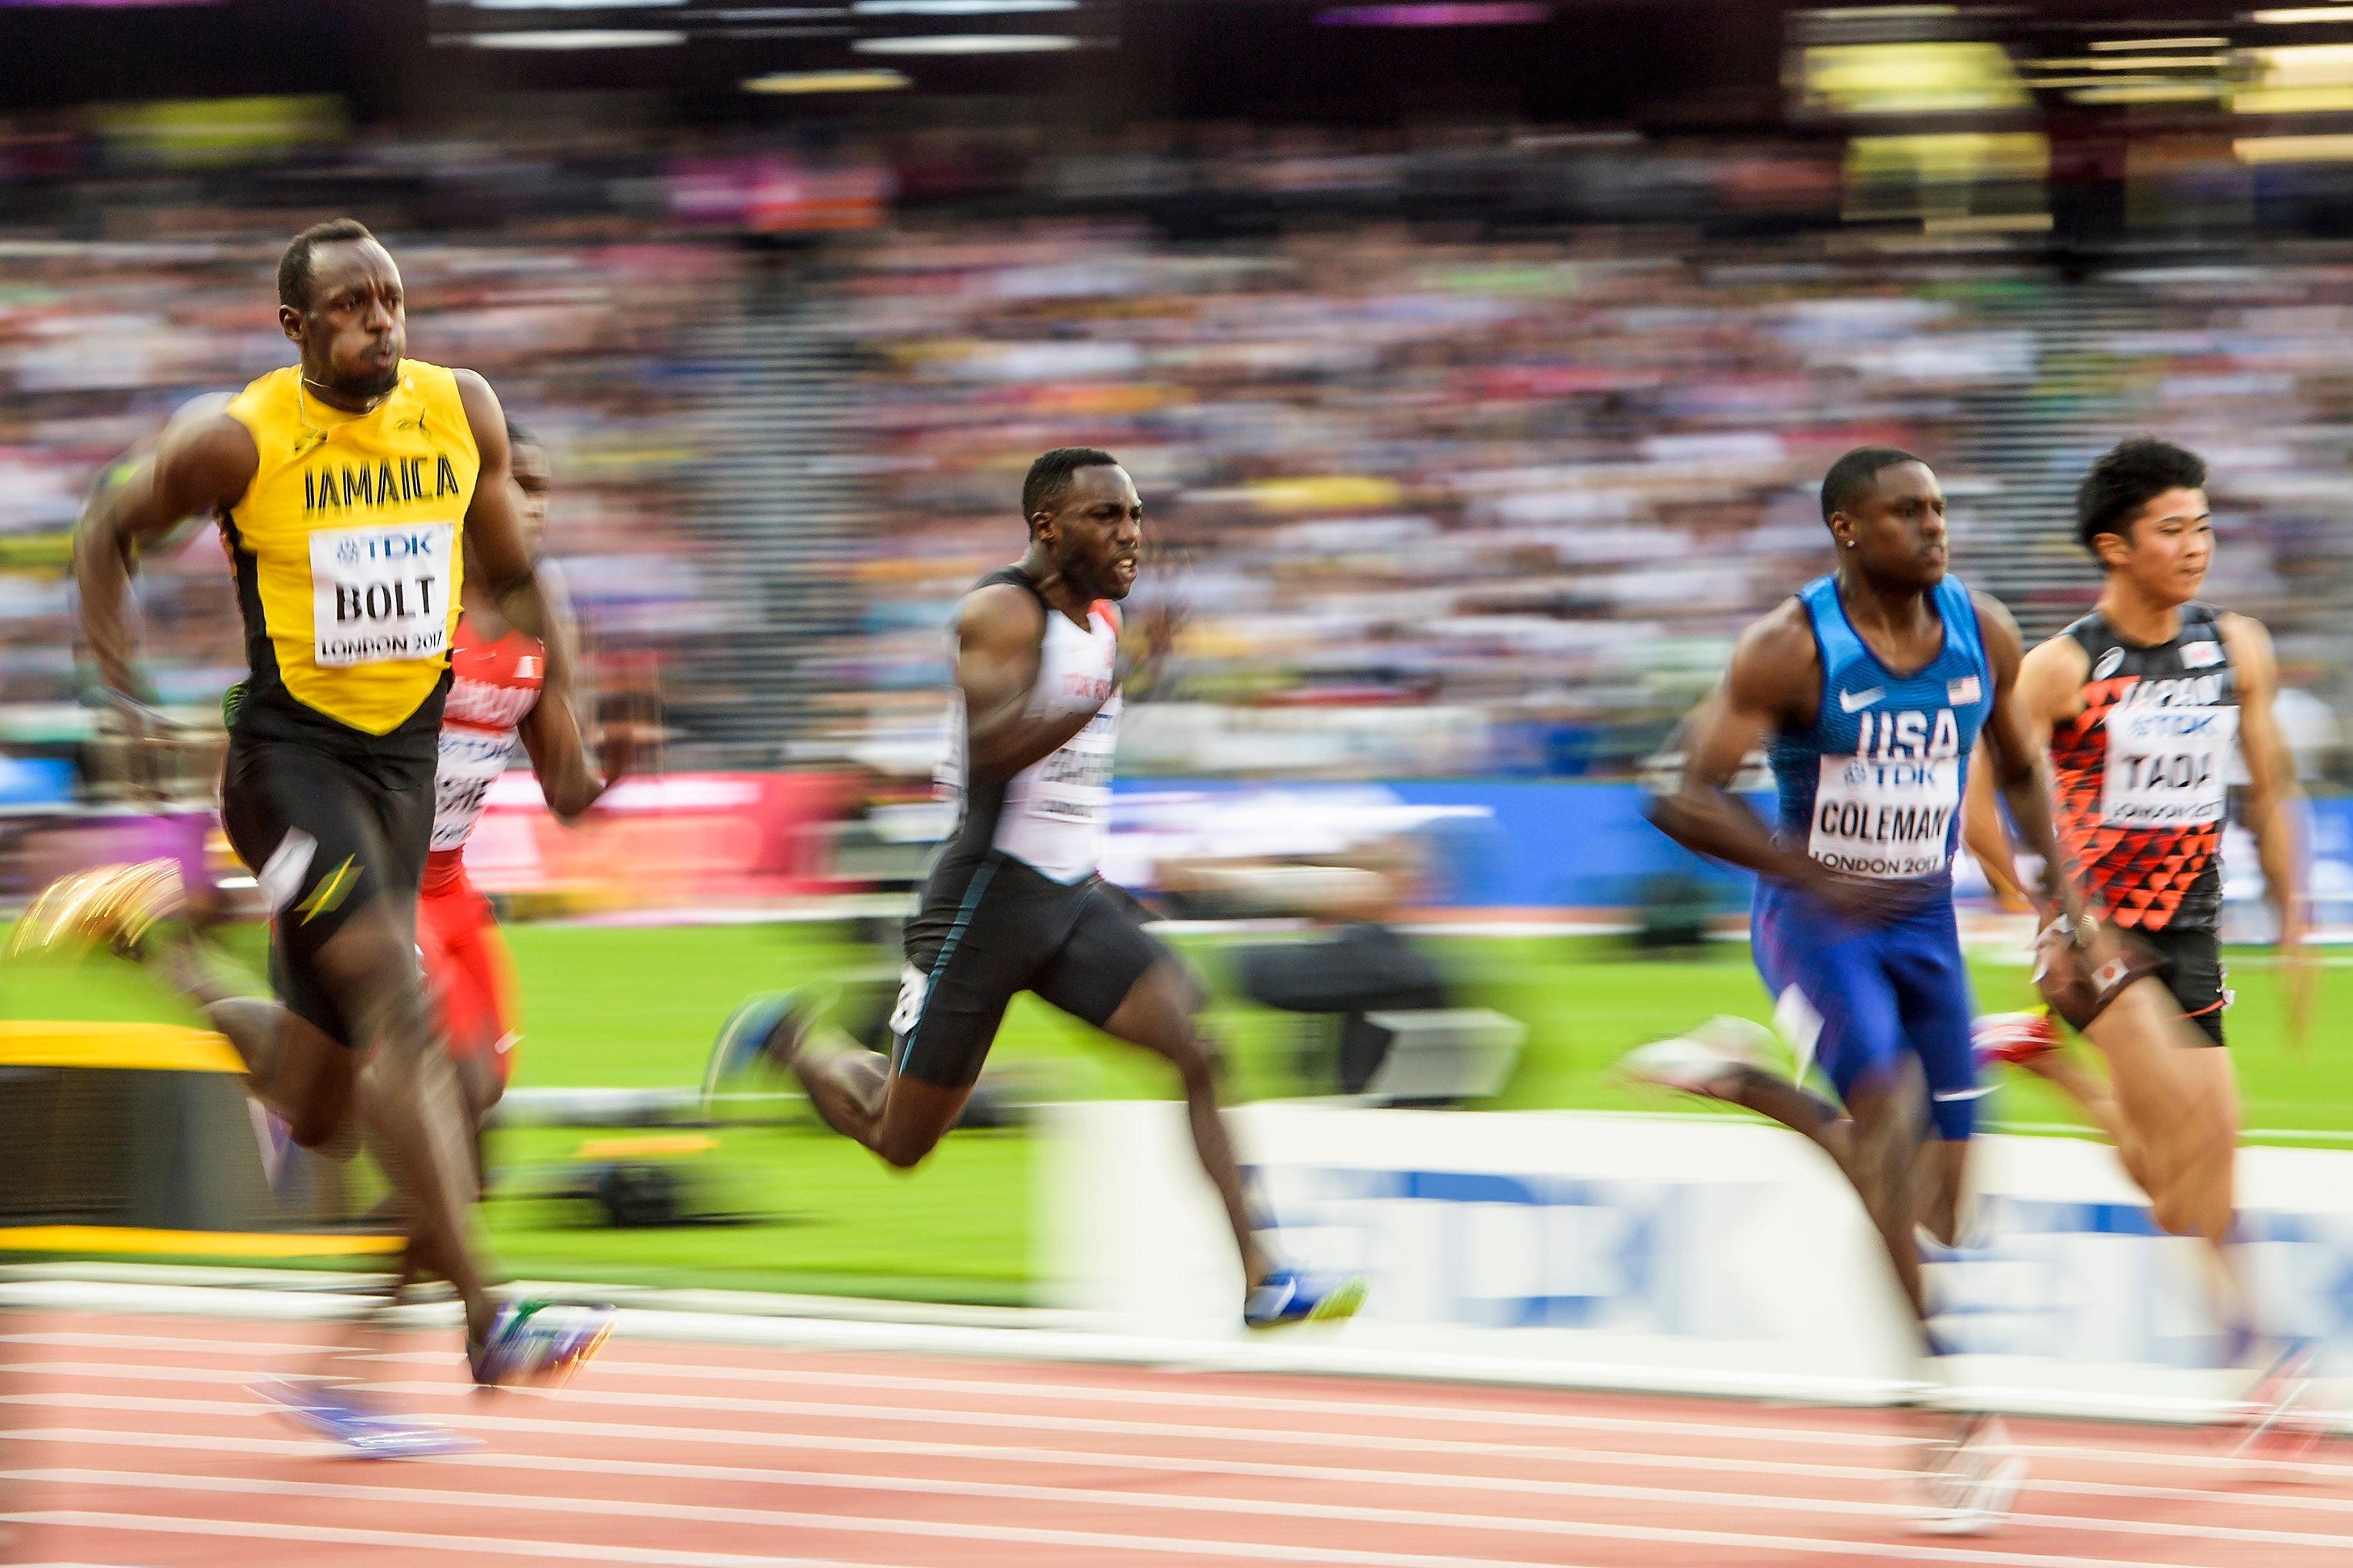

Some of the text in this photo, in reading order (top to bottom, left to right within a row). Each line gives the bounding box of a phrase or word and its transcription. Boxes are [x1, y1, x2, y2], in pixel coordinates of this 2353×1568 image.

[302, 451, 460, 517] JAMAICA
[359, 531, 432, 561] TDK
[335, 575, 436, 624] BOLT
[322, 630, 443, 659] LONDON 2017
[1856, 708, 1960, 760] USA
[1870, 756, 1937, 787] TDK
[1820, 799, 1949, 842] COLEMAN
[1813, 850, 1938, 875] LONDON 2017
